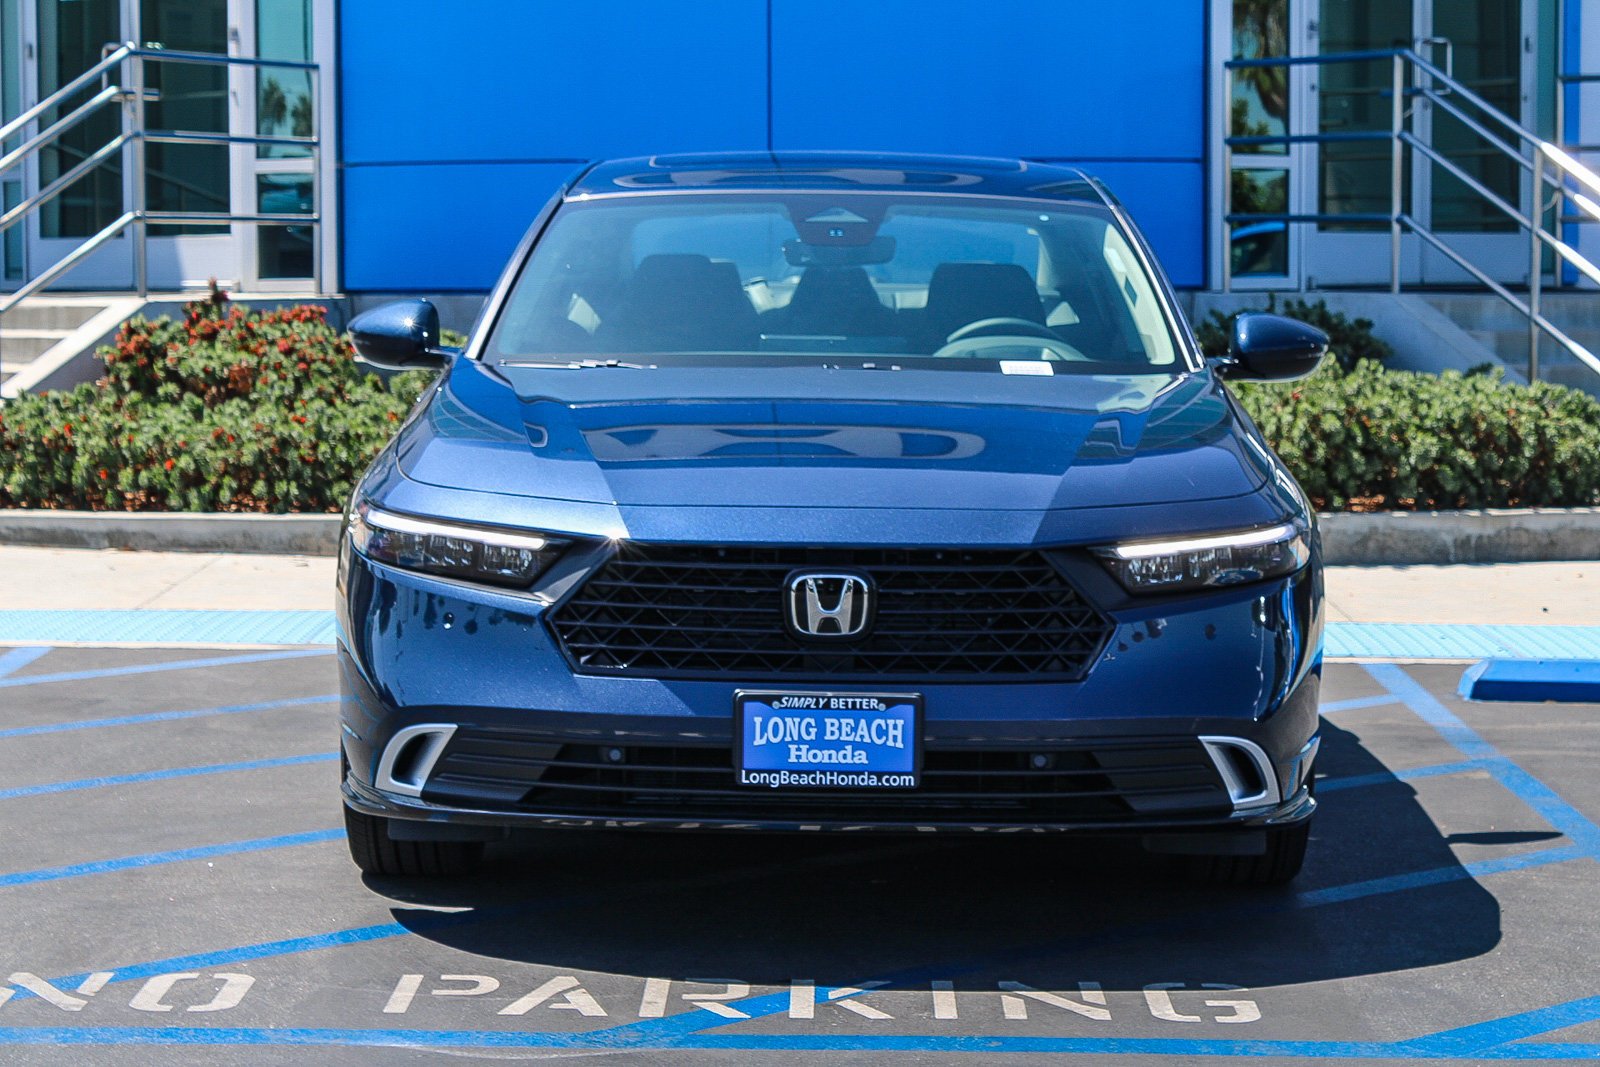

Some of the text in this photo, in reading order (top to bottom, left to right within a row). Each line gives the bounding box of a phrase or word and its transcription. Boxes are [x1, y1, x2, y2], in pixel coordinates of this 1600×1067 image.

[779, 696, 879, 710] SIMPLY BETTER
[753, 716, 904, 748] LONG BEACH
[787, 744, 869, 764] Honda
[741, 769, 915, 788] LongBeachHonda.com
[0, 972, 1262, 1023] NO PARKING
